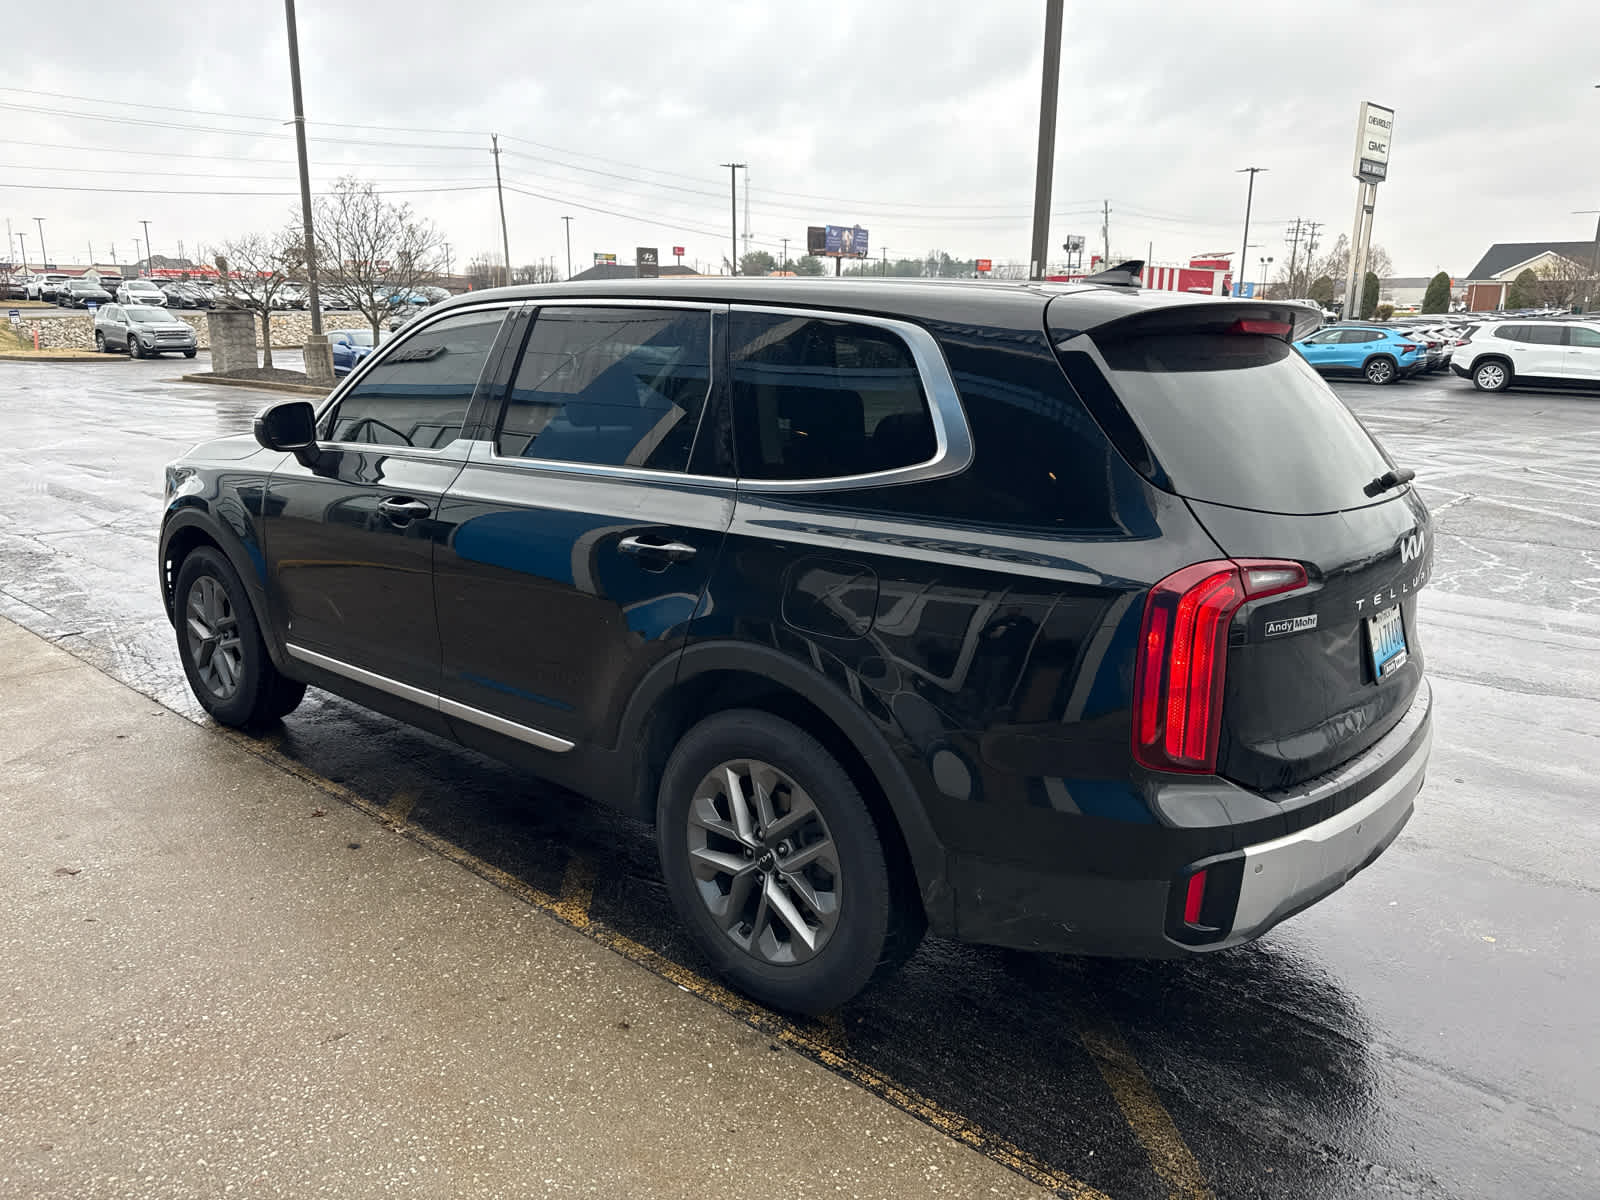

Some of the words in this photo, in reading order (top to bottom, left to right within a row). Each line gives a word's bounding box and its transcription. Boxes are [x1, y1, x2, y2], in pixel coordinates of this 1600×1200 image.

[1368, 141, 1386, 154] GMC
[1267, 621, 1293, 633] Andy
[1294, 616, 1316, 629] Mohr
